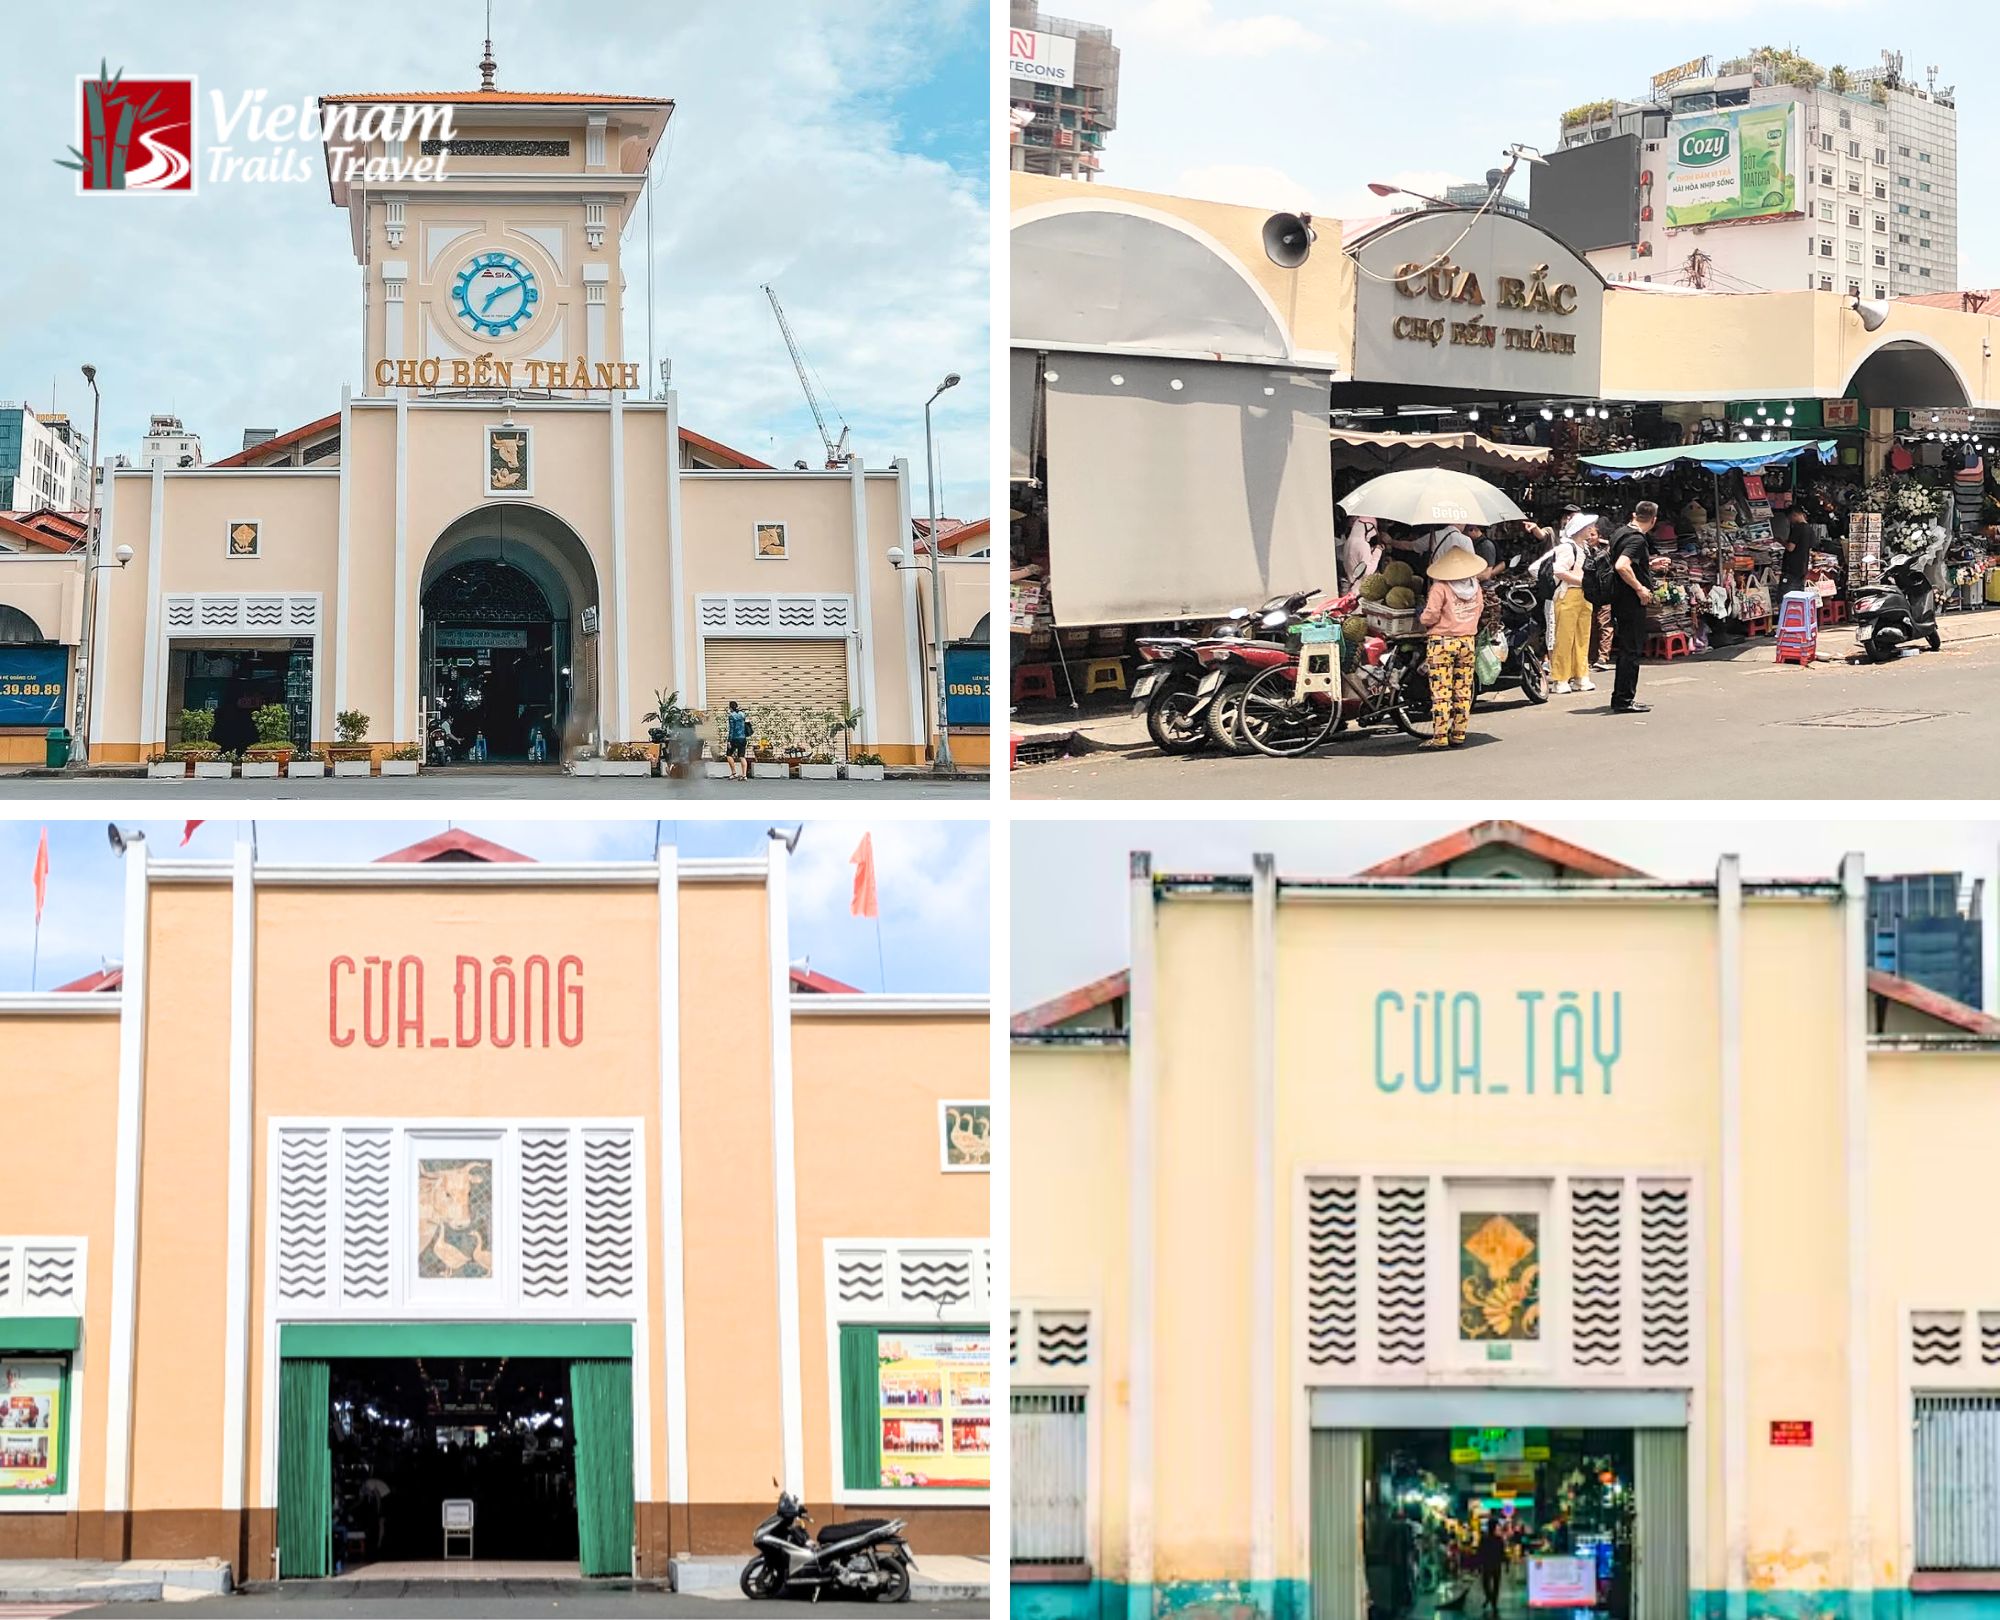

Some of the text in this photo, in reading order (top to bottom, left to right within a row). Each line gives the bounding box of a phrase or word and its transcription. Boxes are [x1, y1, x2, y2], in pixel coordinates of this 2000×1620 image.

[1683, 136, 1725, 158] Cozy
[1716, 176, 1735, 188] SỐNG
[1744, 170, 1771, 188] MATCHA
[487, 253, 504, 265] 12
[481, 268, 512, 278] ASIA
[1394, 254, 1578, 315] CỬA BẮC
[1393, 315, 1446, 348] CHỢ
[1450, 313, 1498, 348] BẾN
[375, 351, 641, 391] CHỢ BẾN THÀNH
